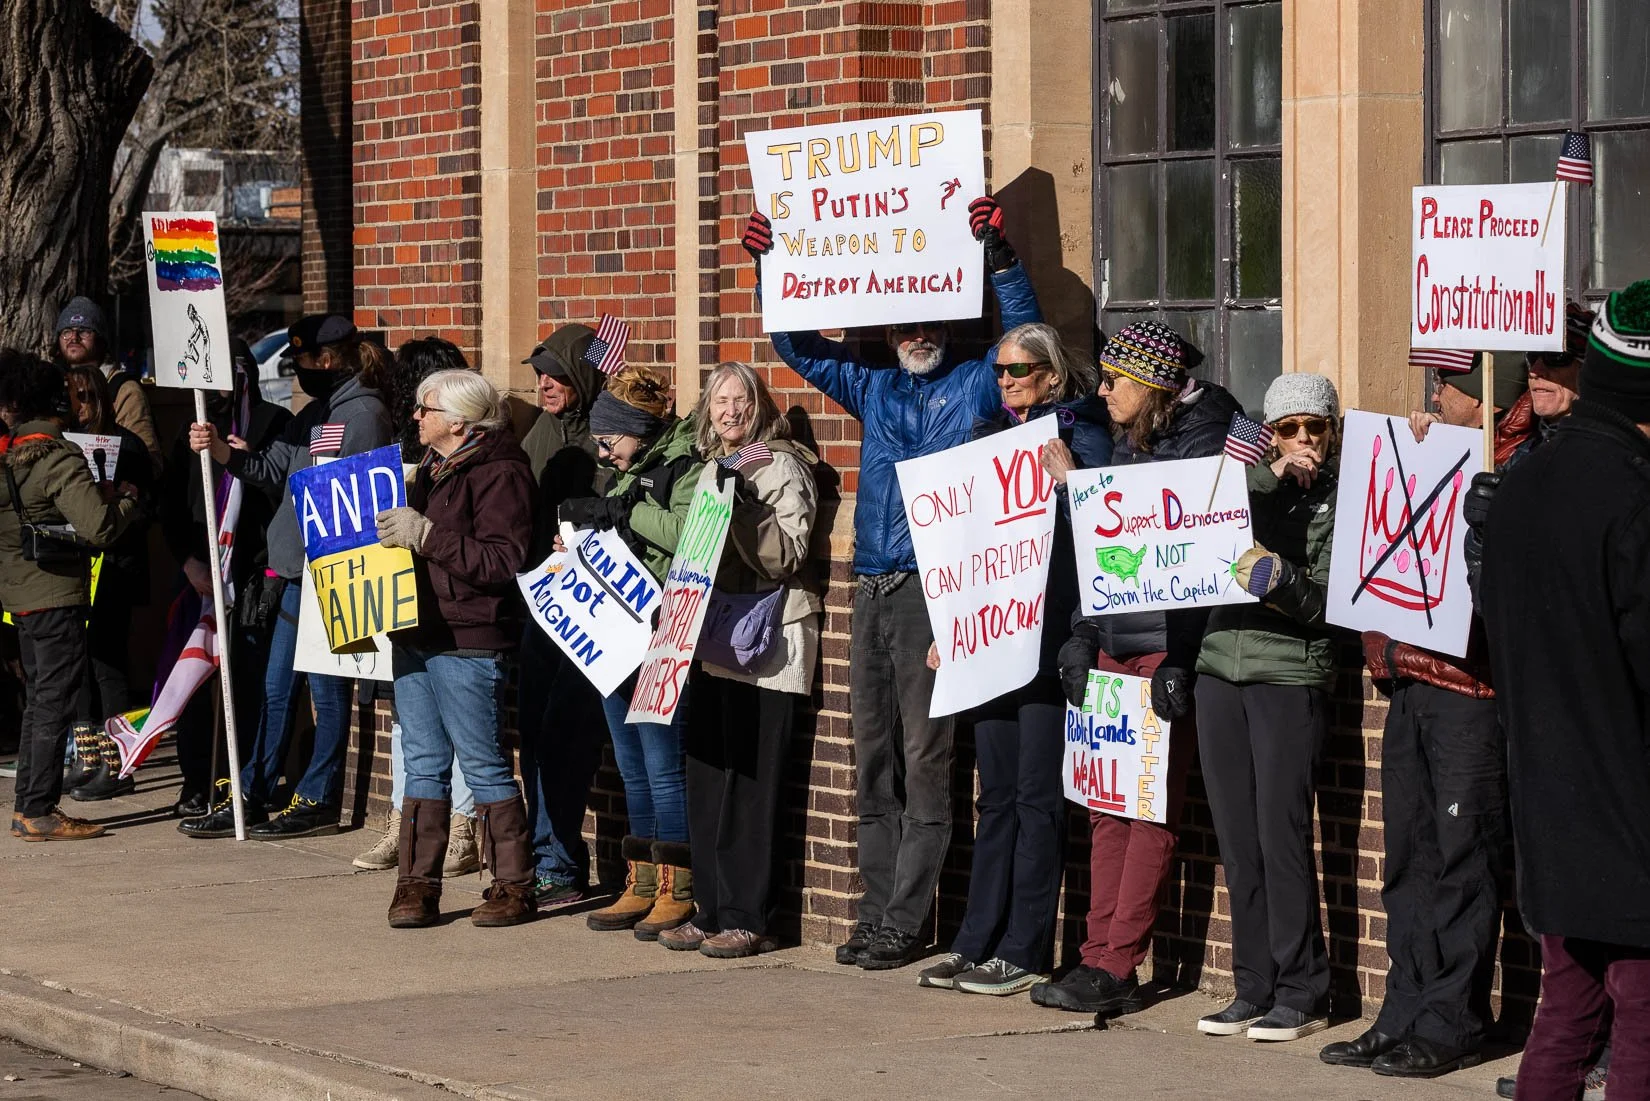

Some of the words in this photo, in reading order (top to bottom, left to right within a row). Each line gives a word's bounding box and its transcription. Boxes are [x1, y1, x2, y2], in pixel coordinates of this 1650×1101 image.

[767, 121, 944, 181] TRUMP
[770, 191, 793, 220] IS
[811, 187, 909, 221] PUTIN'S
[1420, 196, 1473, 239] PLEASE
[1479, 199, 1539, 239] PROCEED
[779, 229, 878, 257] WEAPON
[892, 228, 926, 253] TO
[866, 267, 963, 294] AMERICA!
[1417, 254, 1555, 335] Constitutionally
[293, 466, 398, 547] AND
[911, 475, 974, 527] ONLY
[993, 444, 1056, 514] YOU
[1072, 483, 1098, 510] Here
[1098, 473, 1113, 488] to
[1094, 490, 1161, 538] Support
[1162, 488, 1249, 530] Democracy
[925, 561, 963, 600] CAN
[972, 531, 1052, 586] PREVENT
[1156, 542, 1195, 568] NOT
[610, 561, 655, 613] IN
[1092, 576, 1139, 611] Storm
[1143, 579, 1169, 602] the
[1170, 573, 1219, 603] Capitol
[952, 592, 1043, 662] AUTOCRAC
[1067, 710, 1089, 745] Public
[1089, 714, 1136, 750] Lands
[1073, 750, 1087, 796] We
[1088, 757, 1126, 802] ALL
